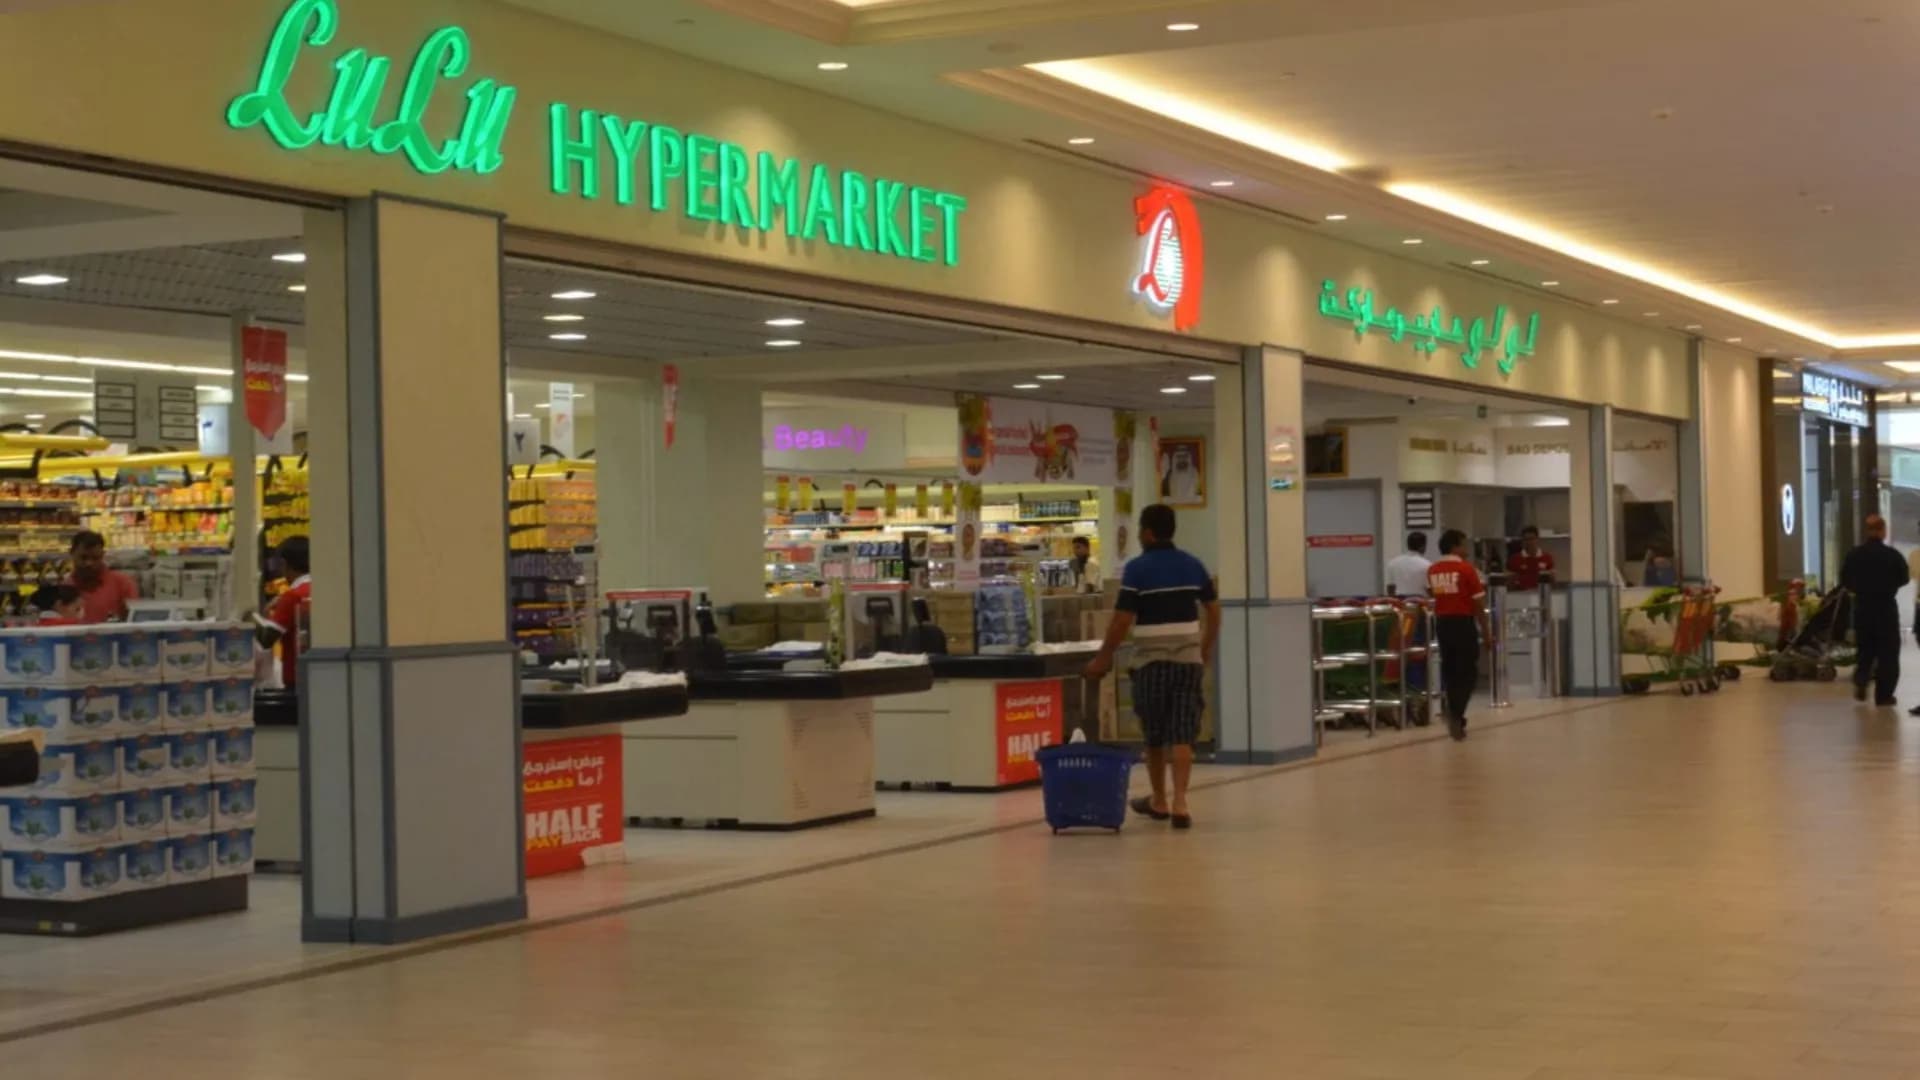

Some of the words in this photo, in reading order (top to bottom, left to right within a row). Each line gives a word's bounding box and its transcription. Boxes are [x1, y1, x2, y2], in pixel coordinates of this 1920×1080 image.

[226, 0, 517, 173] LuLu
[550, 102, 967, 266] HYPERMARKET
[774, 424, 868, 454] Beauty
[1007, 731, 1052, 755] HALF
[525, 803, 604, 840] HALF
